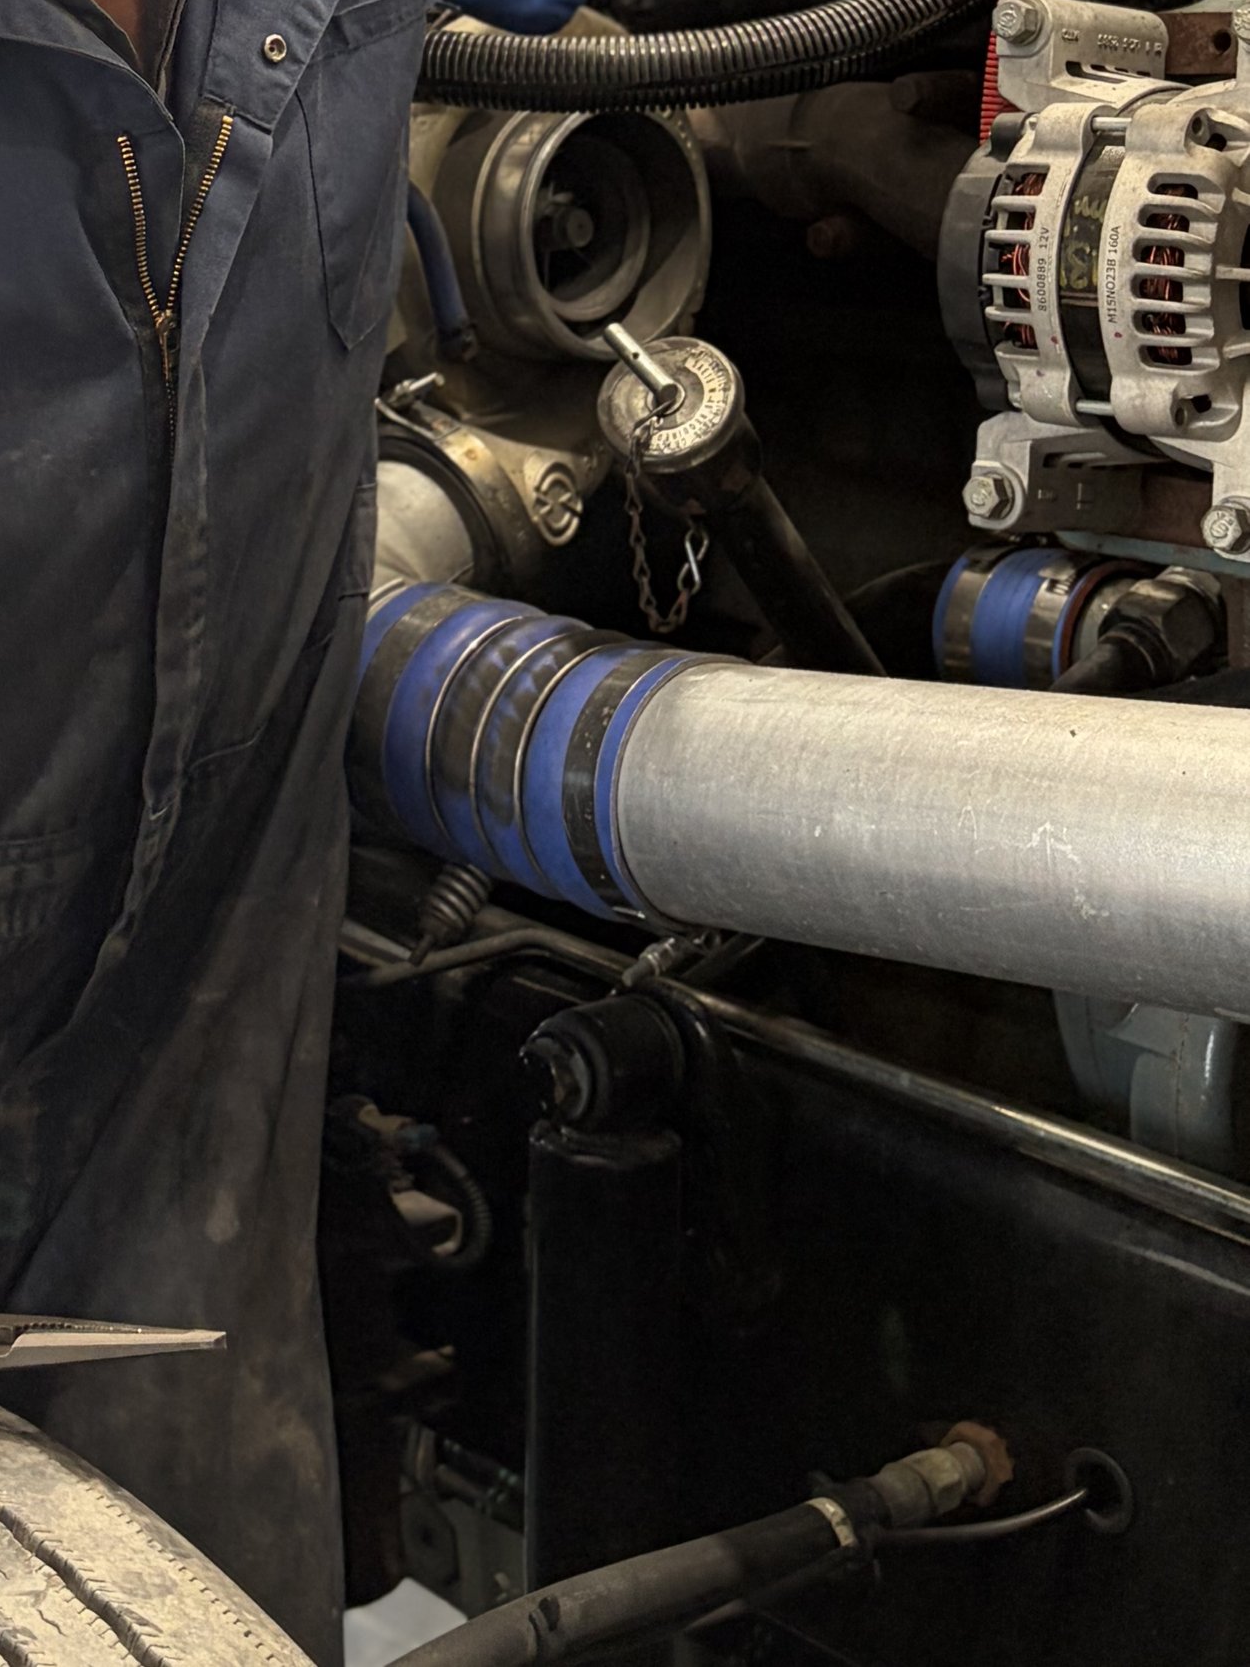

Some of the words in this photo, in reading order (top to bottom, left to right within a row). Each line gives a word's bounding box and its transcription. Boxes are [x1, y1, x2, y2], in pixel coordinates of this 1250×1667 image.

[1040, 226, 1050, 250] 12V
[1107, 225, 1121, 256] 160A
[1036, 256, 1048, 312] 8600889
